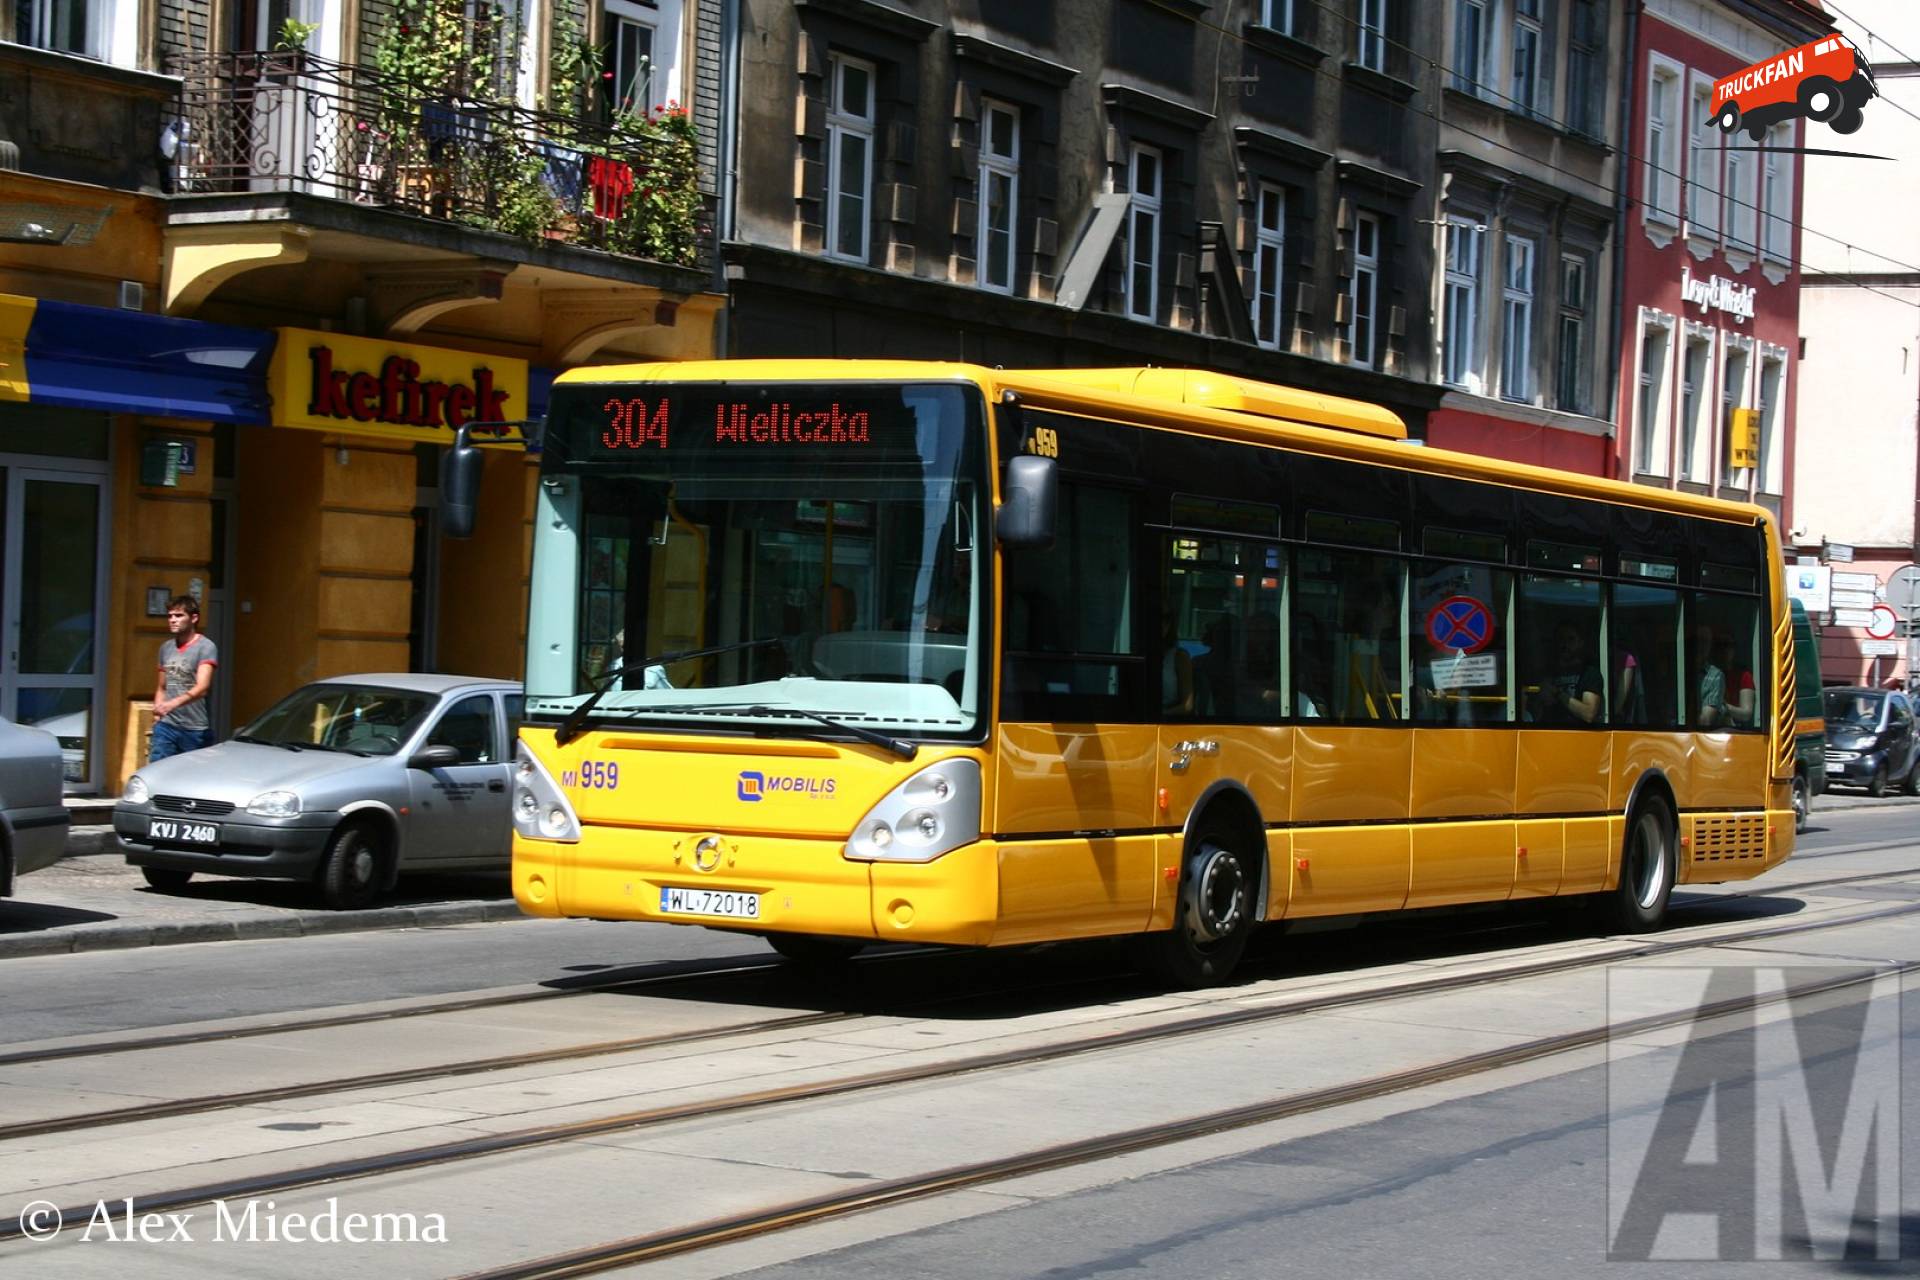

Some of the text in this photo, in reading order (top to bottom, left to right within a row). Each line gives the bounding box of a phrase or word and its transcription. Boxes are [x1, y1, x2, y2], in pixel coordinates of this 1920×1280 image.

[307, 345, 512, 437] kefirek
[602, 398, 870, 449] 304 Wieliczka
[1036, 427, 1058, 459] 959
[562, 761, 619, 790] MI 959
[767, 777, 837, 793] MOBILIS
[150, 822, 216, 842] KVJ 2460
[703, 892, 757, 916] 72018
